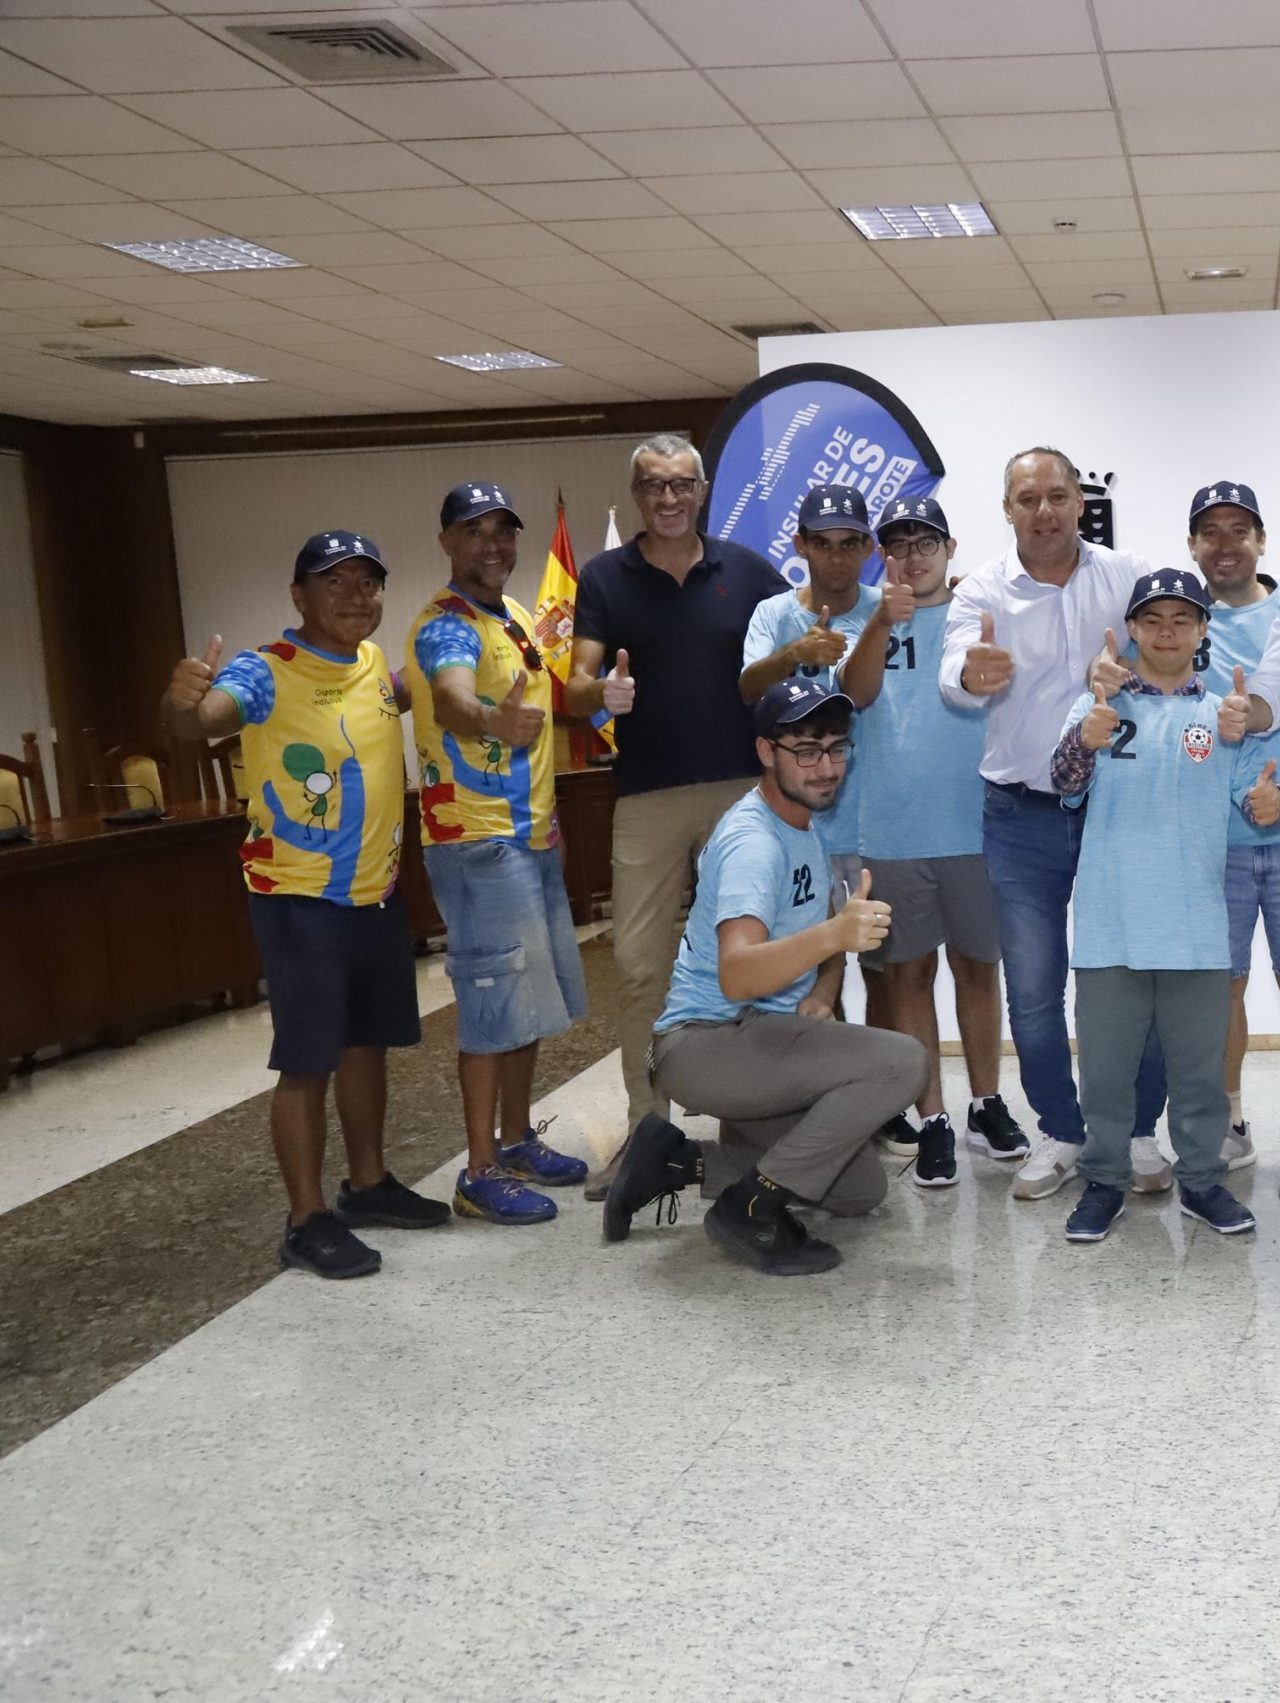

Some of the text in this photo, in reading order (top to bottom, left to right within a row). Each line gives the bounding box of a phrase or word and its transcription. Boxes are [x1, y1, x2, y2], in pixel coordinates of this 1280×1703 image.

[823, 425, 853, 461] DE
[885, 636, 916, 670] 21
[1111, 719, 1137, 760] 2
[793, 864, 816, 908] 22
